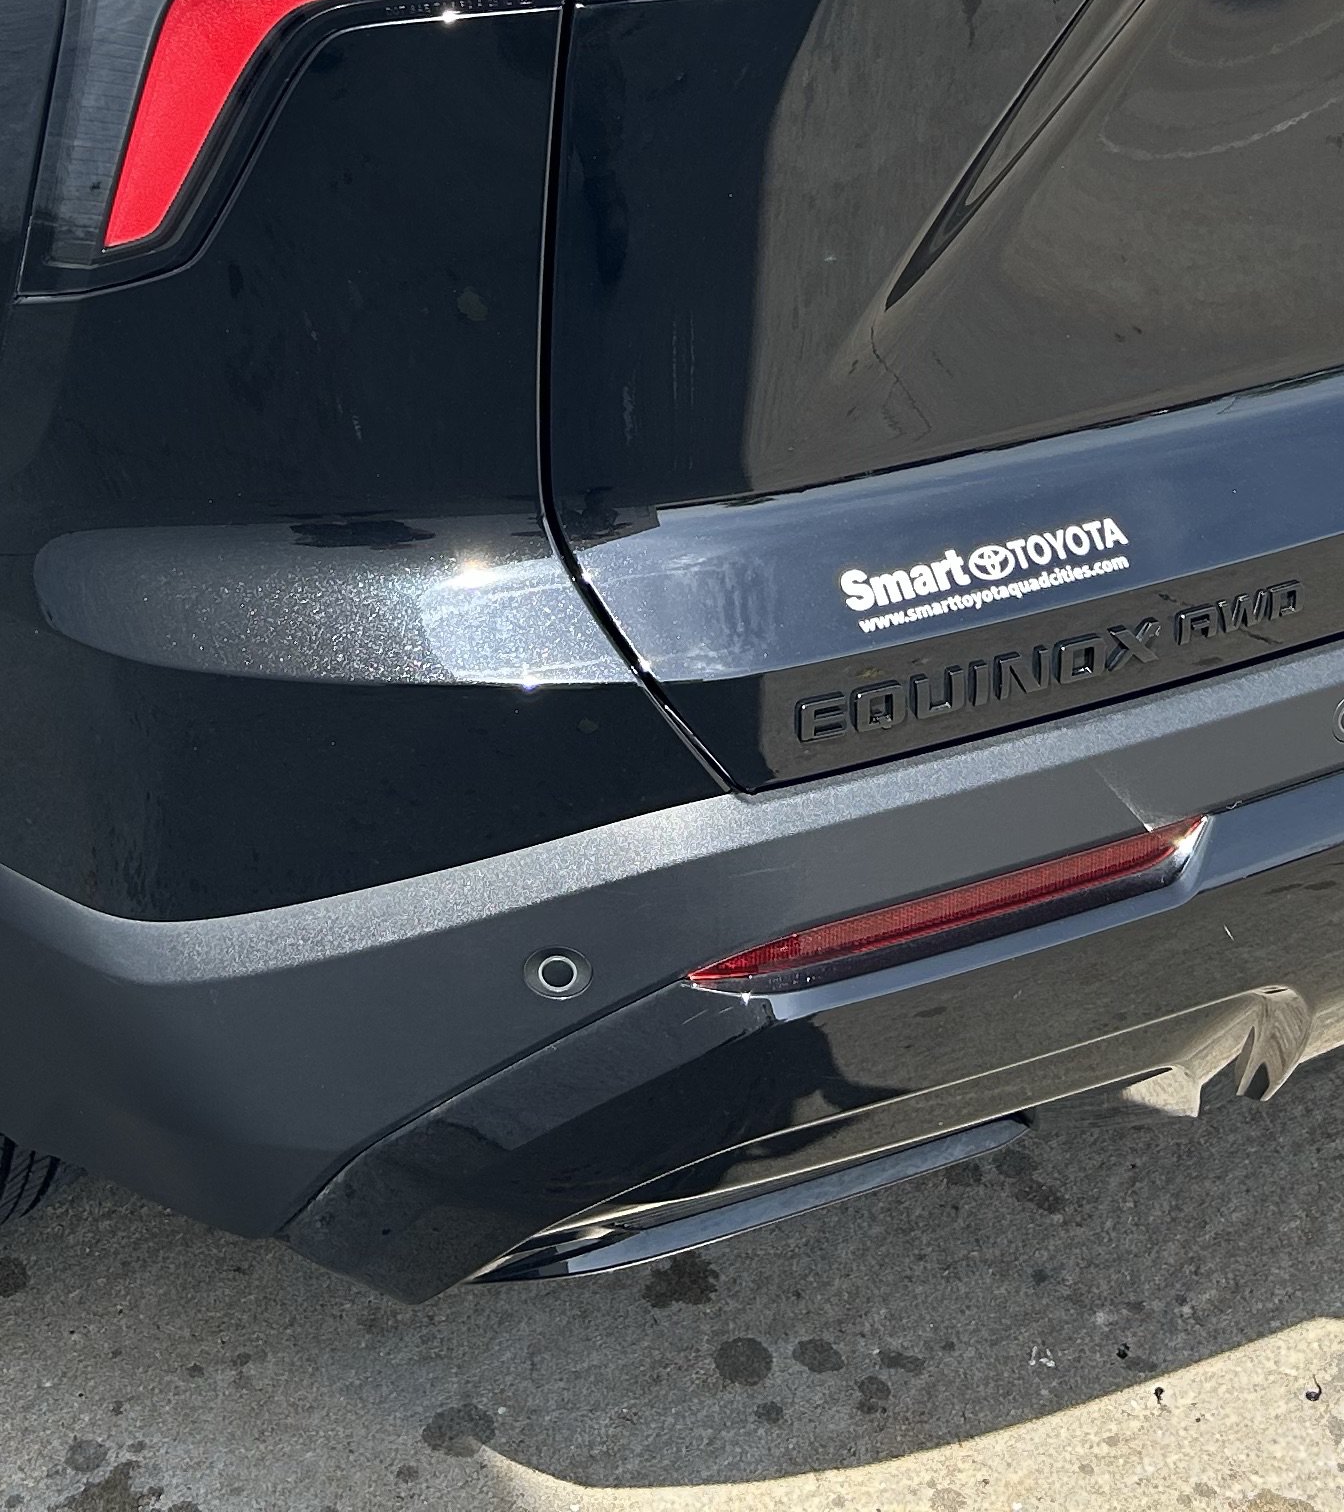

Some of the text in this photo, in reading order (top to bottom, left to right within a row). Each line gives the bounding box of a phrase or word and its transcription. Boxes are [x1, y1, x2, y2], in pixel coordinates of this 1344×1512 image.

[840, 518, 1128, 611] Smart TOYOTA
[858, 554, 1129, 633] www.smarttoyotaquadcities.com
[795, 579, 1305, 743] EQUINOX AWD
